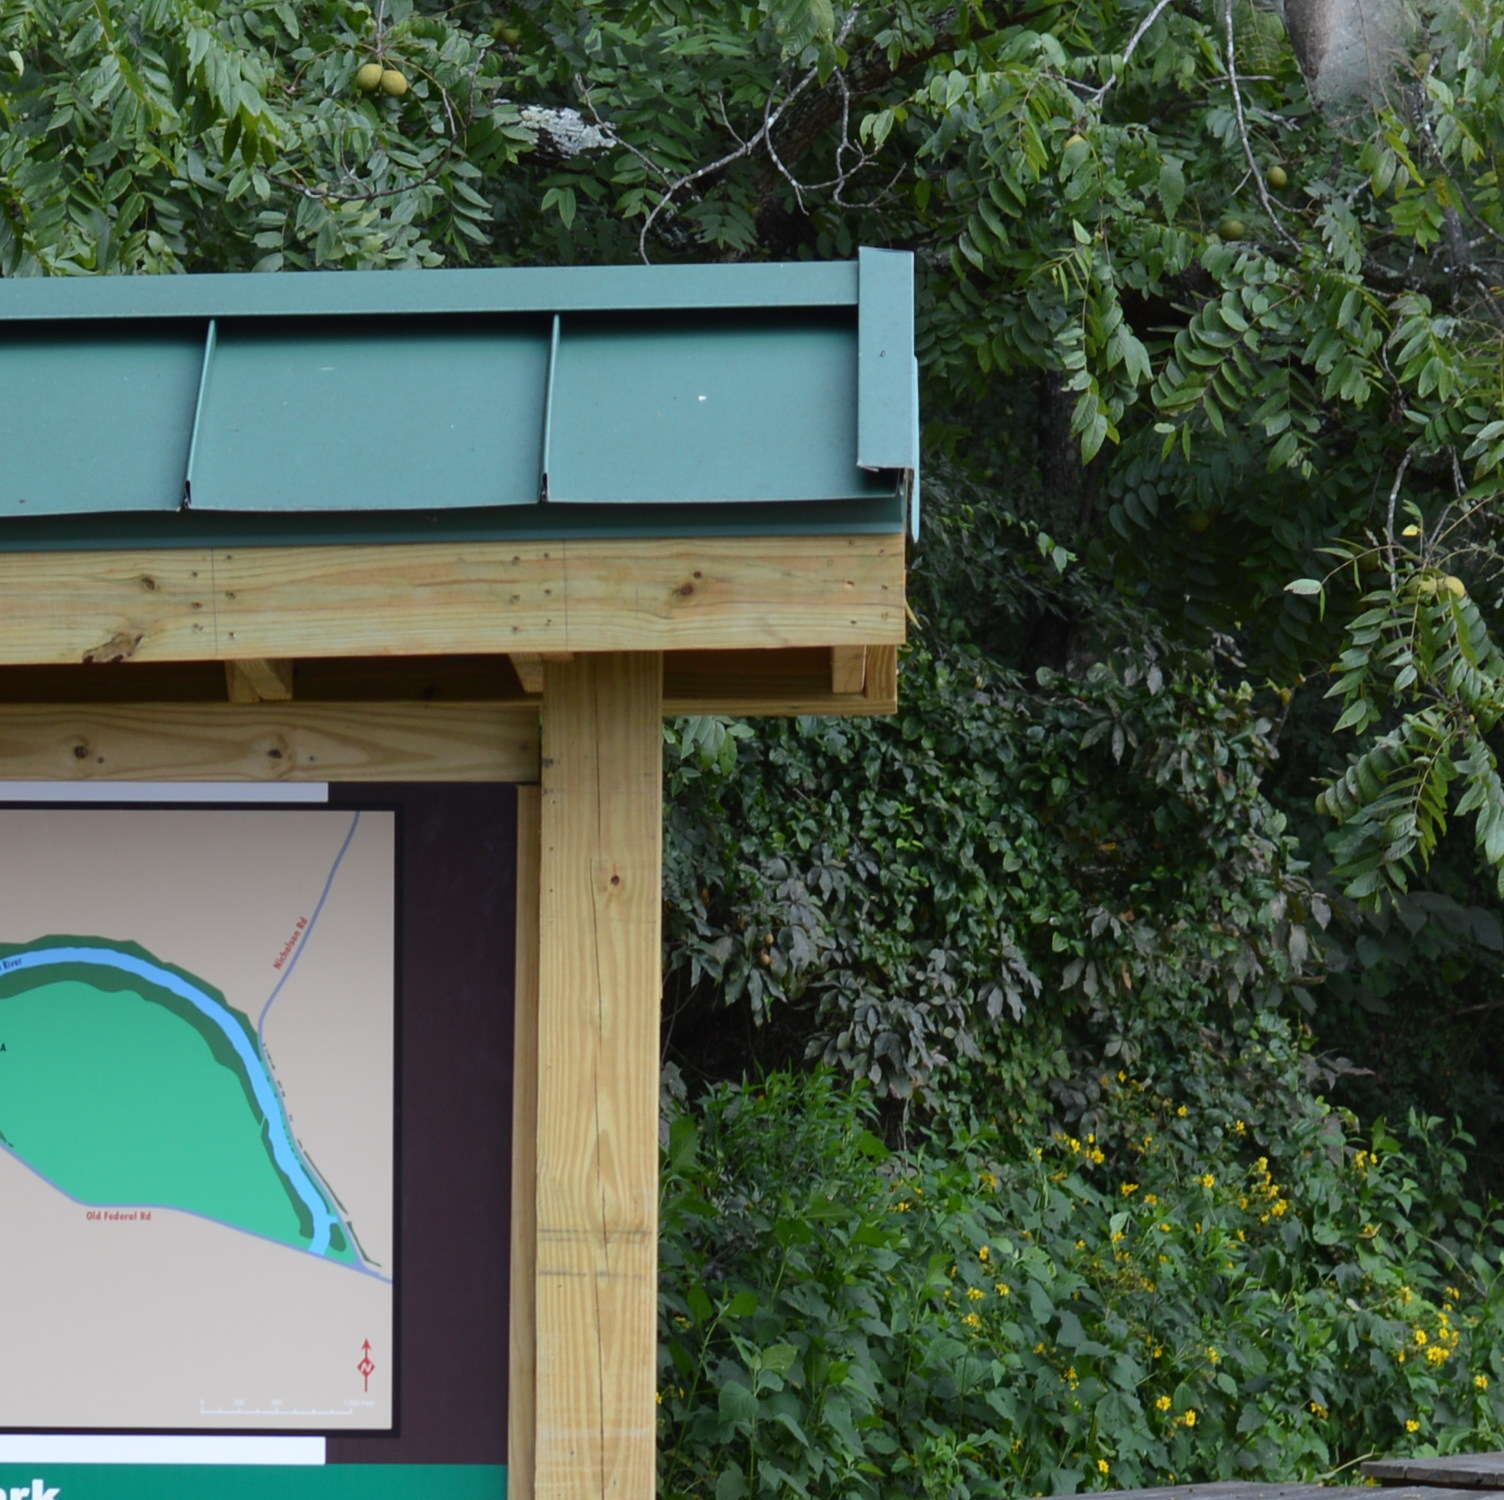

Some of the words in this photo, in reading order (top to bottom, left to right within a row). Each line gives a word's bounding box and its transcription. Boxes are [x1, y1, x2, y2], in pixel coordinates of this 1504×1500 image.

[272, 930, 301, 970] Nicholson
[296, 915, 308, 930] Rd
[2, 958, 23, 969] River
[86, 1211, 101, 1221] Old
[104, 1211, 137, 1221] Federal
[140, 1211, 152, 1221] Rd
